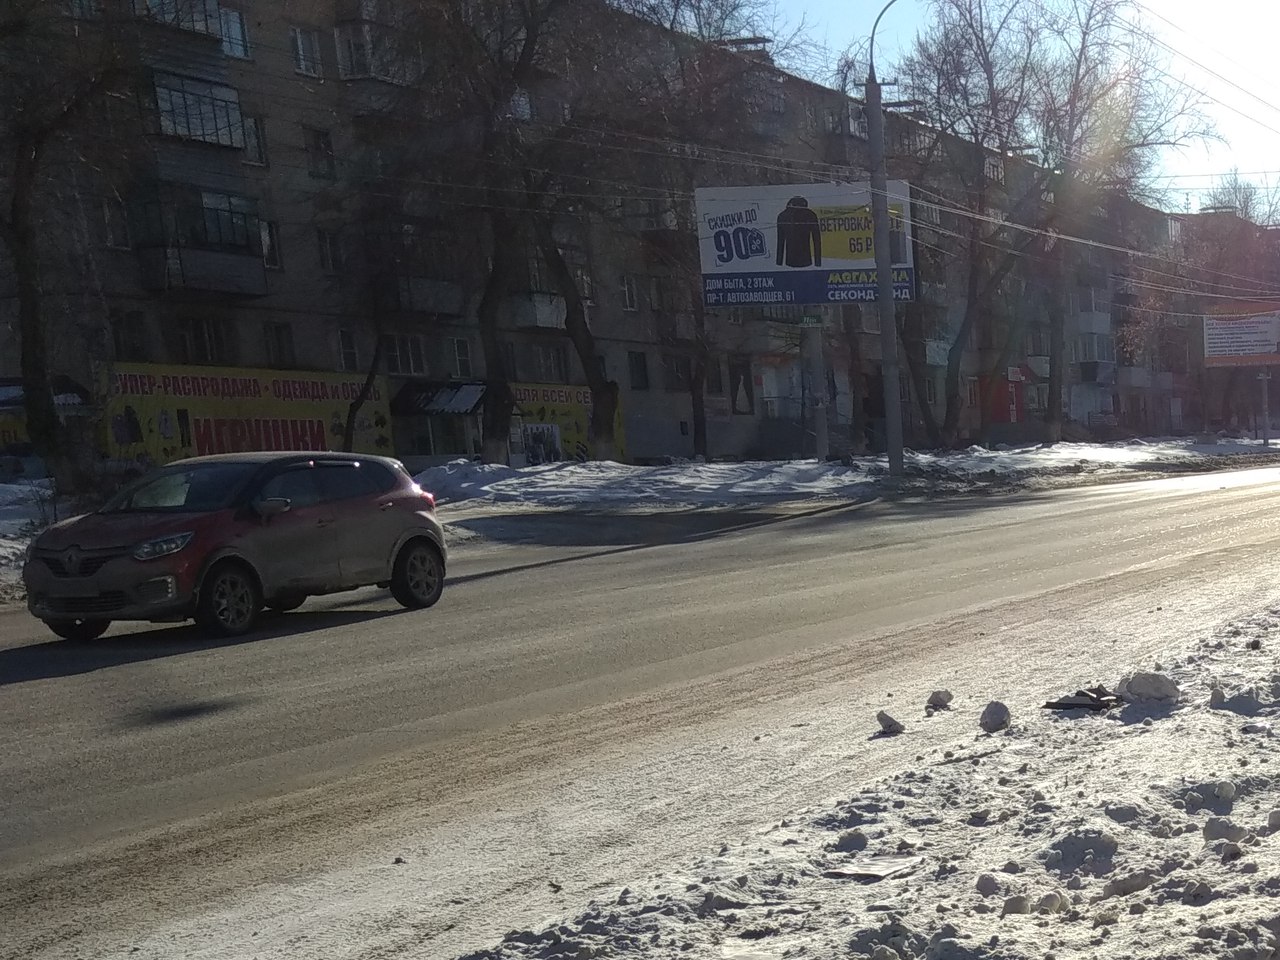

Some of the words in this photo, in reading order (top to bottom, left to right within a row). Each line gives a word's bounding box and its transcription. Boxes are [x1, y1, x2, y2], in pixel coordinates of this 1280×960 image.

[708, 211, 743, 231] СКИДКИ
[745, 208, 758, 224] ДО
[848, 237, 863, 253] 65
[706, 279, 722, 290] ДОМ
[724, 278, 747, 289] БЫТА,
[747, 278, 752, 289] 2
[753, 277, 775, 288] ЭТАЖ
[707, 292, 726, 303] ПР-Т.
[785, 290, 795, 302] 61
[828, 289, 911, 302] СЕКОНД-НД
[272, 379, 329, 402] ОДЕЖДА
[514, 388, 539, 404] ДЛЯ
[542, 388, 573, 405] ВСЕЙ
[193, 417, 328, 457] ИГРУШКИ
